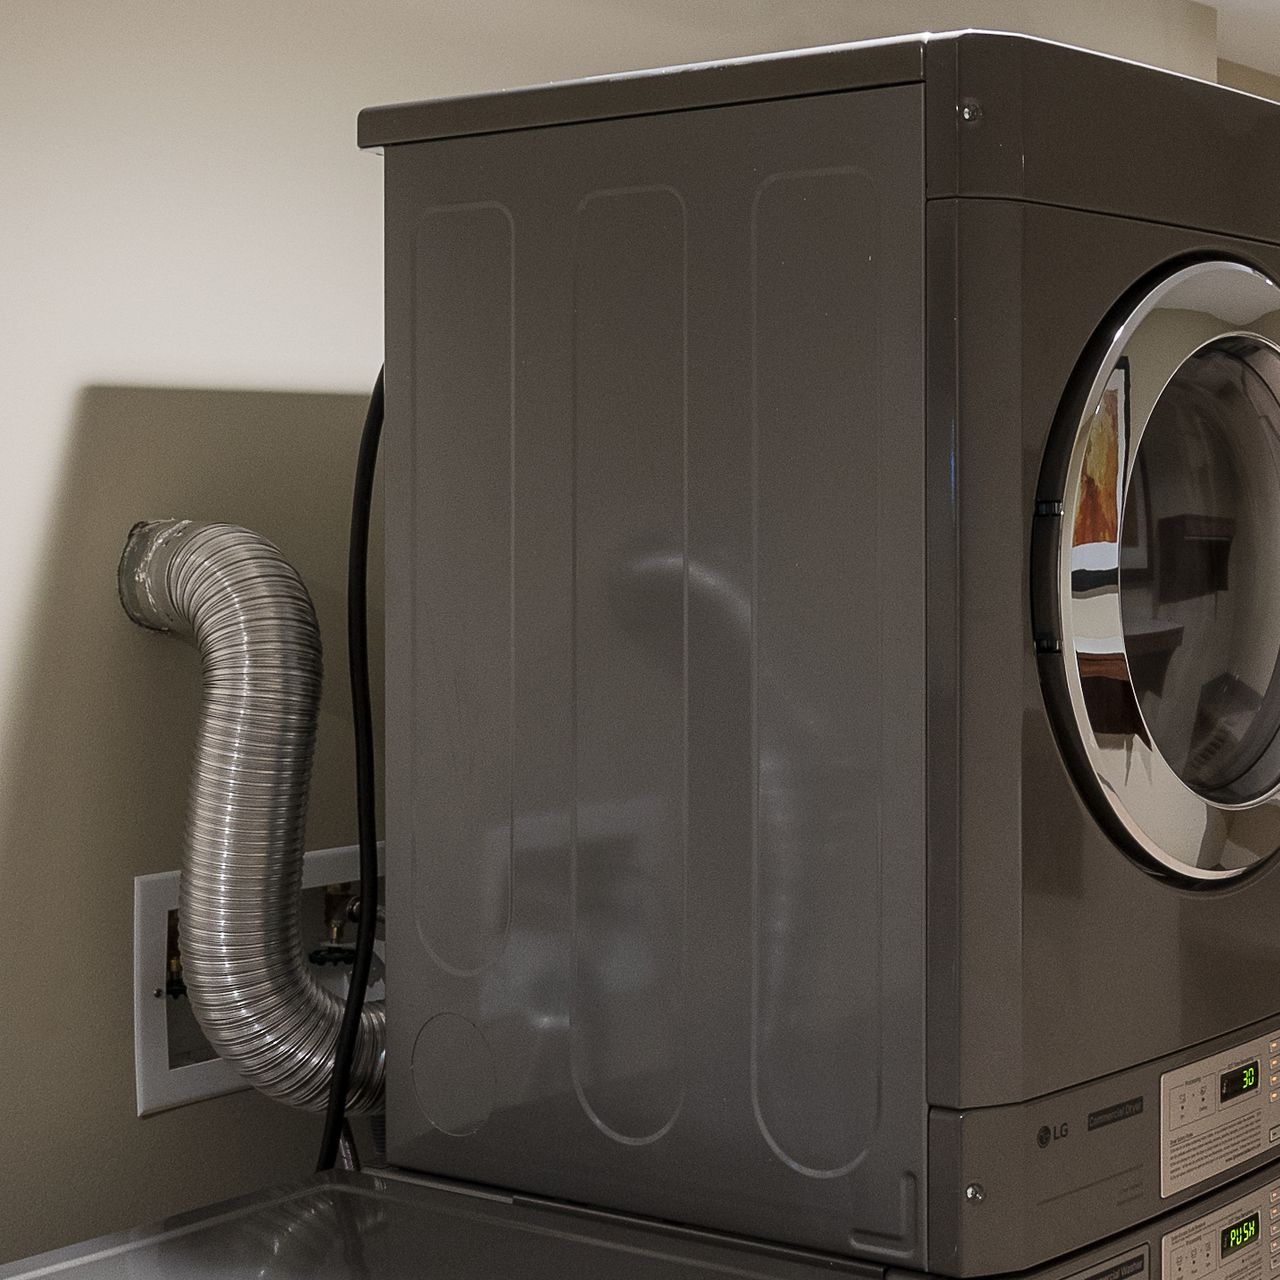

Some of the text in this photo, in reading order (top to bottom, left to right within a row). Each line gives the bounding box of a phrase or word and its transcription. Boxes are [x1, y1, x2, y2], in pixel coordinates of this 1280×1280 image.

[1242, 1067, 1255, 1089] 30
[1053, 1122, 1069, 1141] LG
[1230, 1220, 1255, 1247] PUSH
